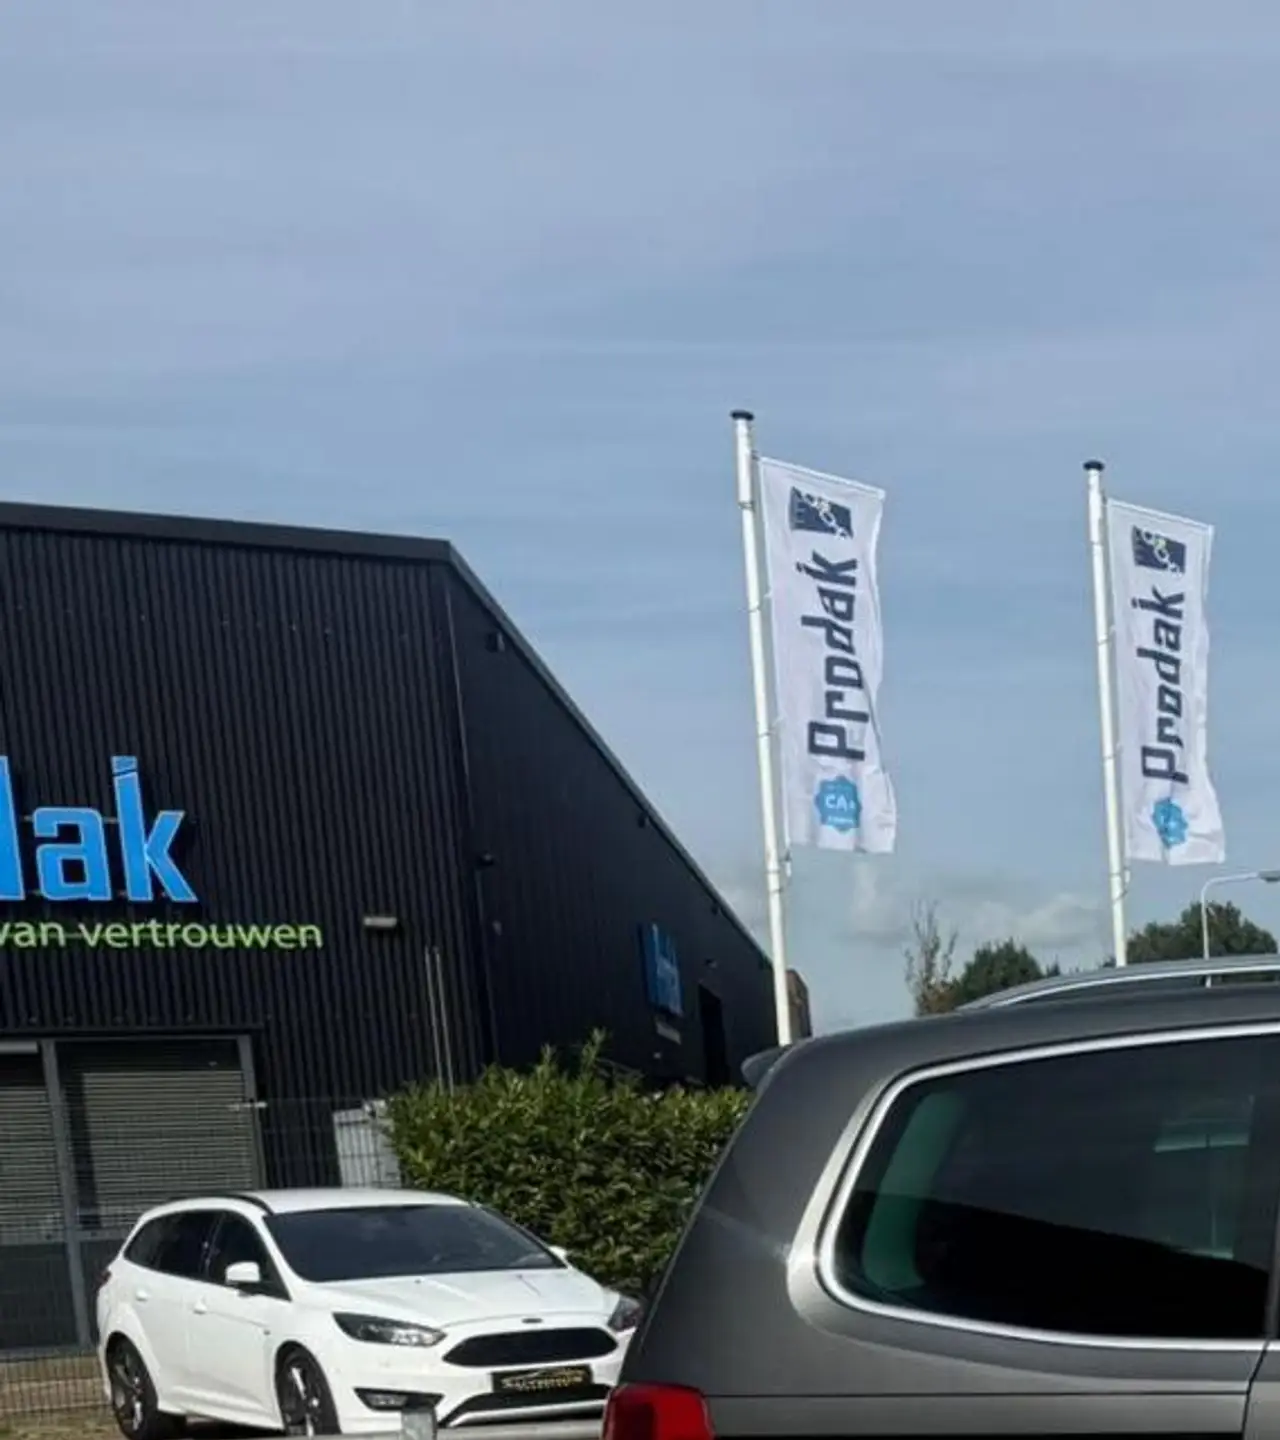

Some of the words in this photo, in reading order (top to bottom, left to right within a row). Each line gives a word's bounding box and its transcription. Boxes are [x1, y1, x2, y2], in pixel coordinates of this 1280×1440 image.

[796, 549, 870, 761] Prodak
[1131, 583, 1190, 784] Prodak
[78, 919, 323, 949] vertrouwen
